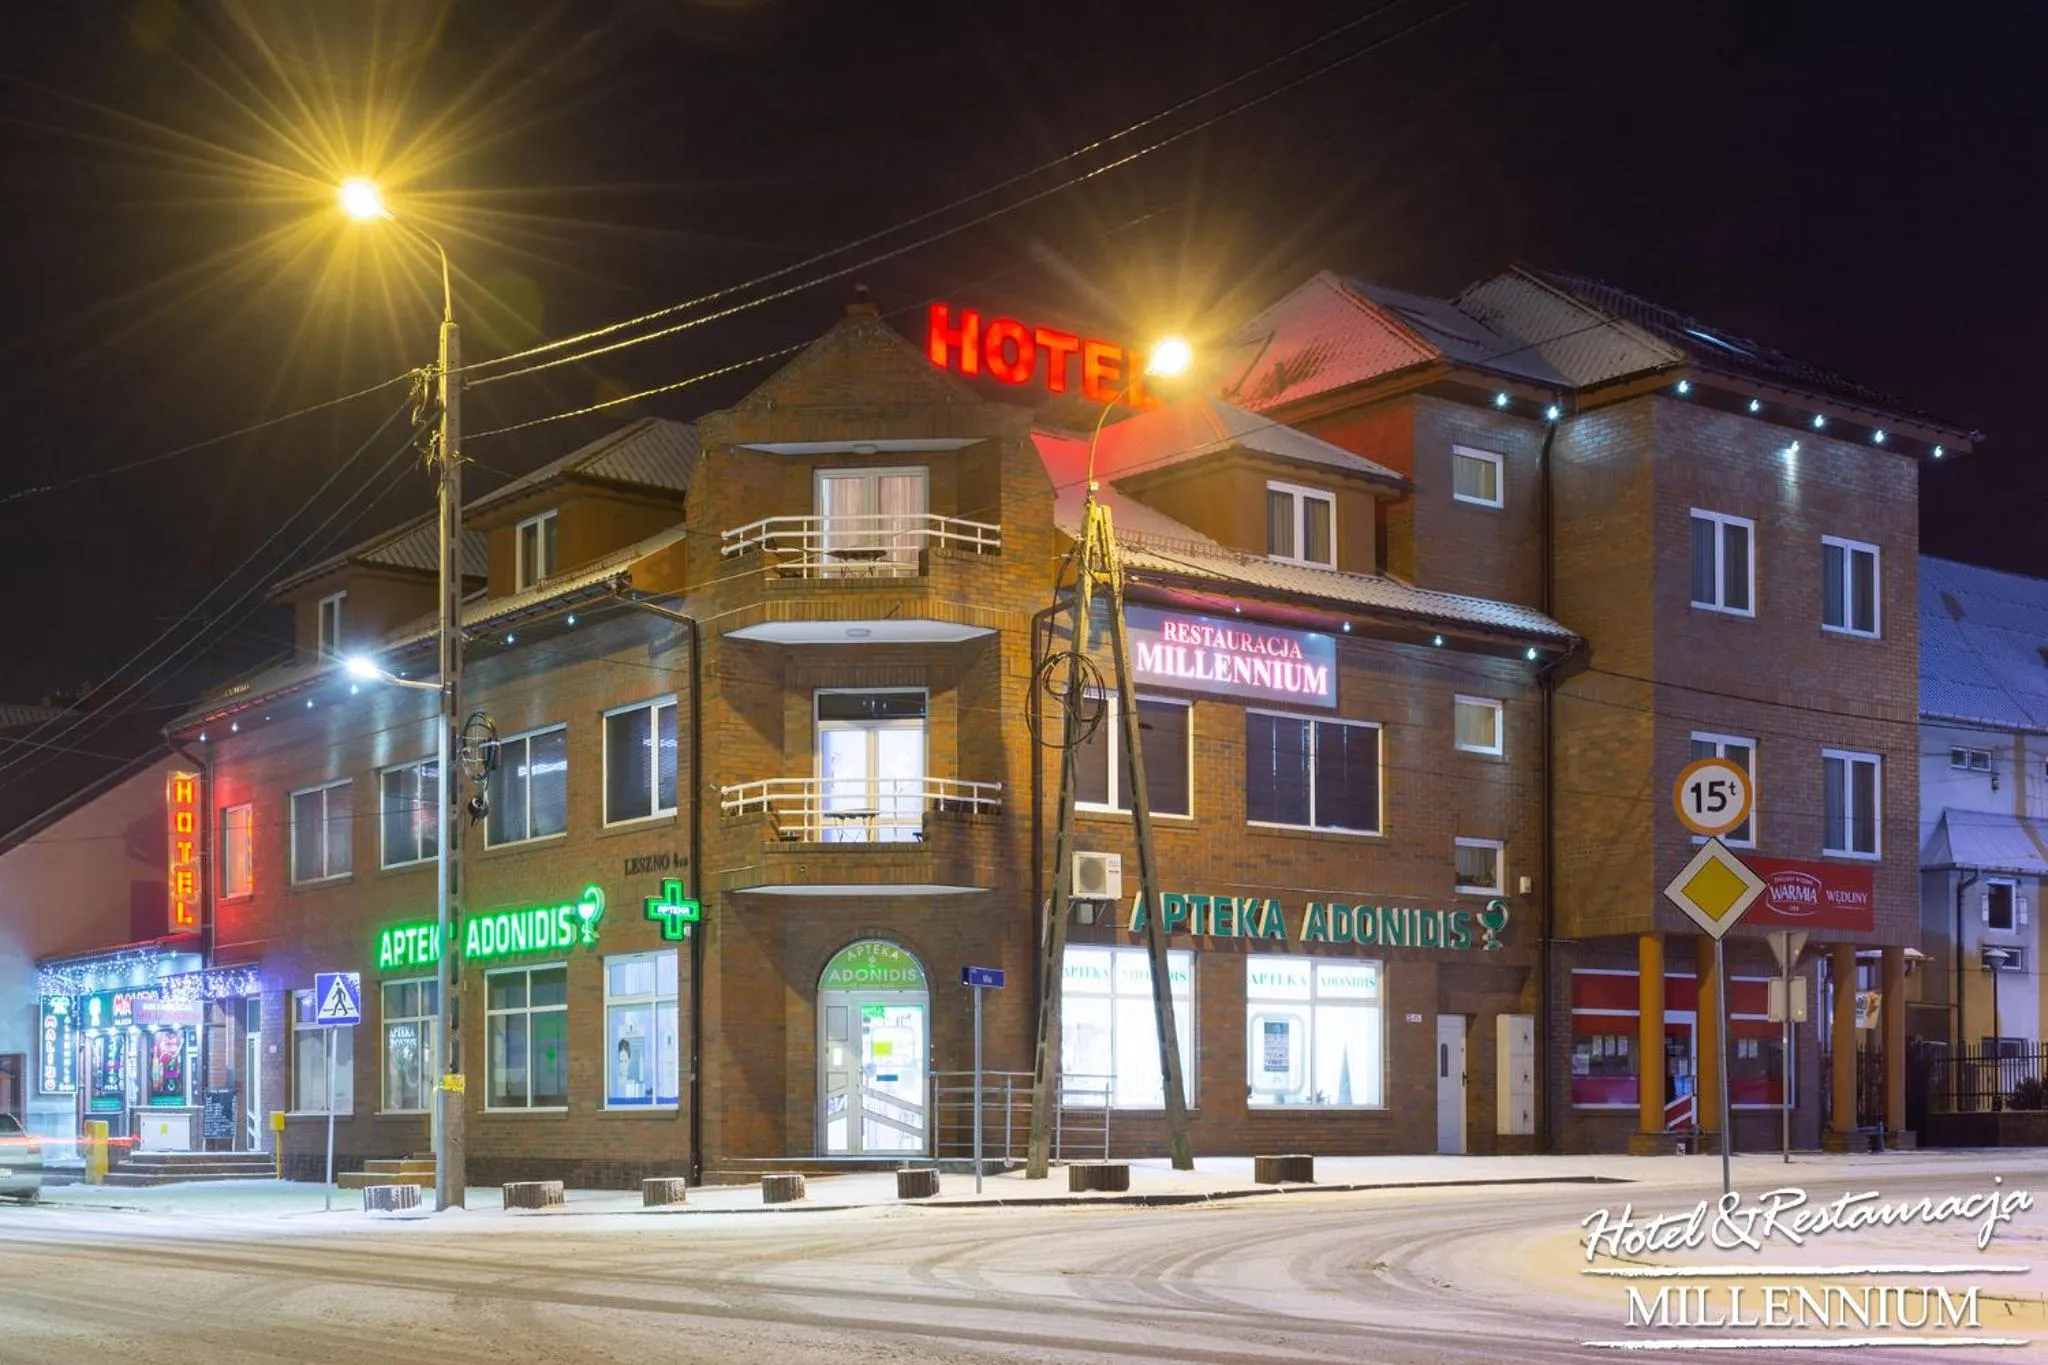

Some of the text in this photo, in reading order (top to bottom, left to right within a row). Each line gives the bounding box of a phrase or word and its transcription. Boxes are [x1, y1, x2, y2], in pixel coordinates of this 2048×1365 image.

[928, 303, 1160, 411] HOTEL
[1163, 621, 1303, 660] RESTAURACJA
[1135, 641, 1328, 695] MILLENNIUM
[175, 780, 194, 925] HOTEL
[624, 854, 670, 876] LESZNO
[1769, 884, 1818, 903] WARMIA
[1825, 890, 1868, 904] WĘDLINY
[380, 906, 572, 968] APTEK ADONIDIS
[1301, 901, 1472, 949] ADONIDIS
[847, 944, 900, 961] APTEKA
[828, 967, 917, 982] ADONIDIS
